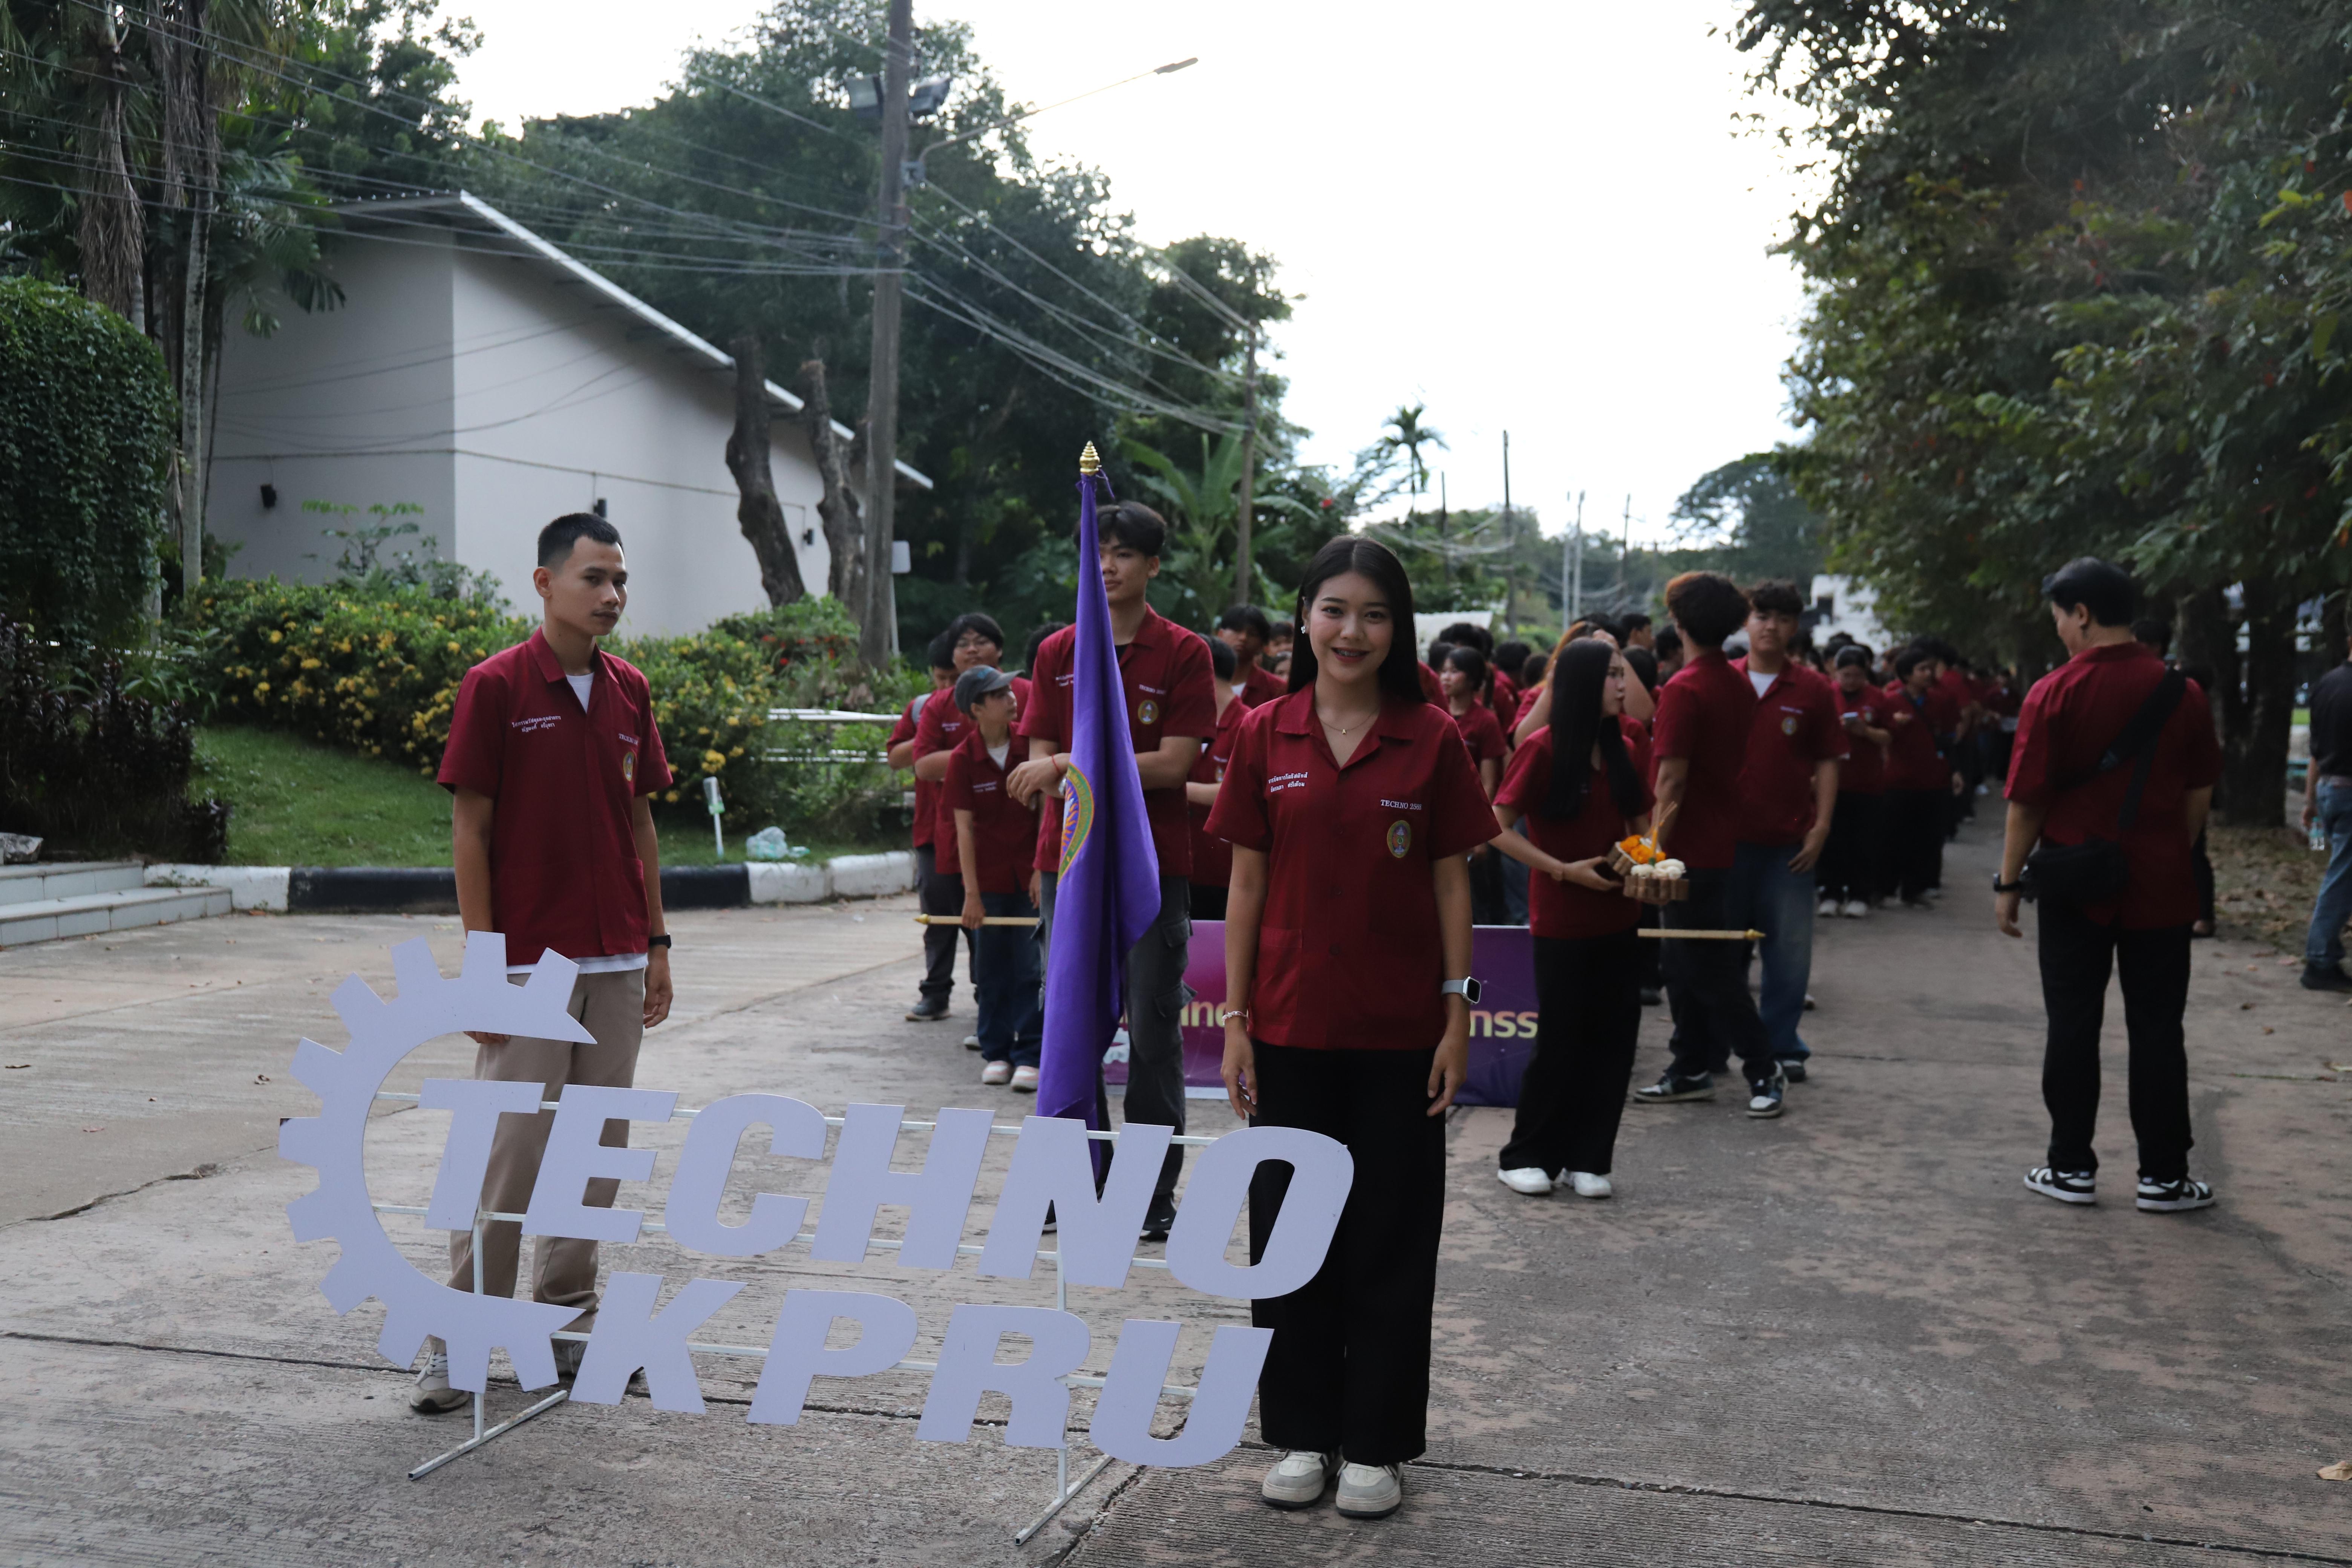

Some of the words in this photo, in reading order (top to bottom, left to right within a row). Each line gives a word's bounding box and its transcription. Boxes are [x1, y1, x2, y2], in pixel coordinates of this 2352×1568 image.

[1380, 799, 1408, 809] TECHNO
[418, 1077, 1354, 1299] TECHNO
[569, 1270, 1274, 1468] KPRU
